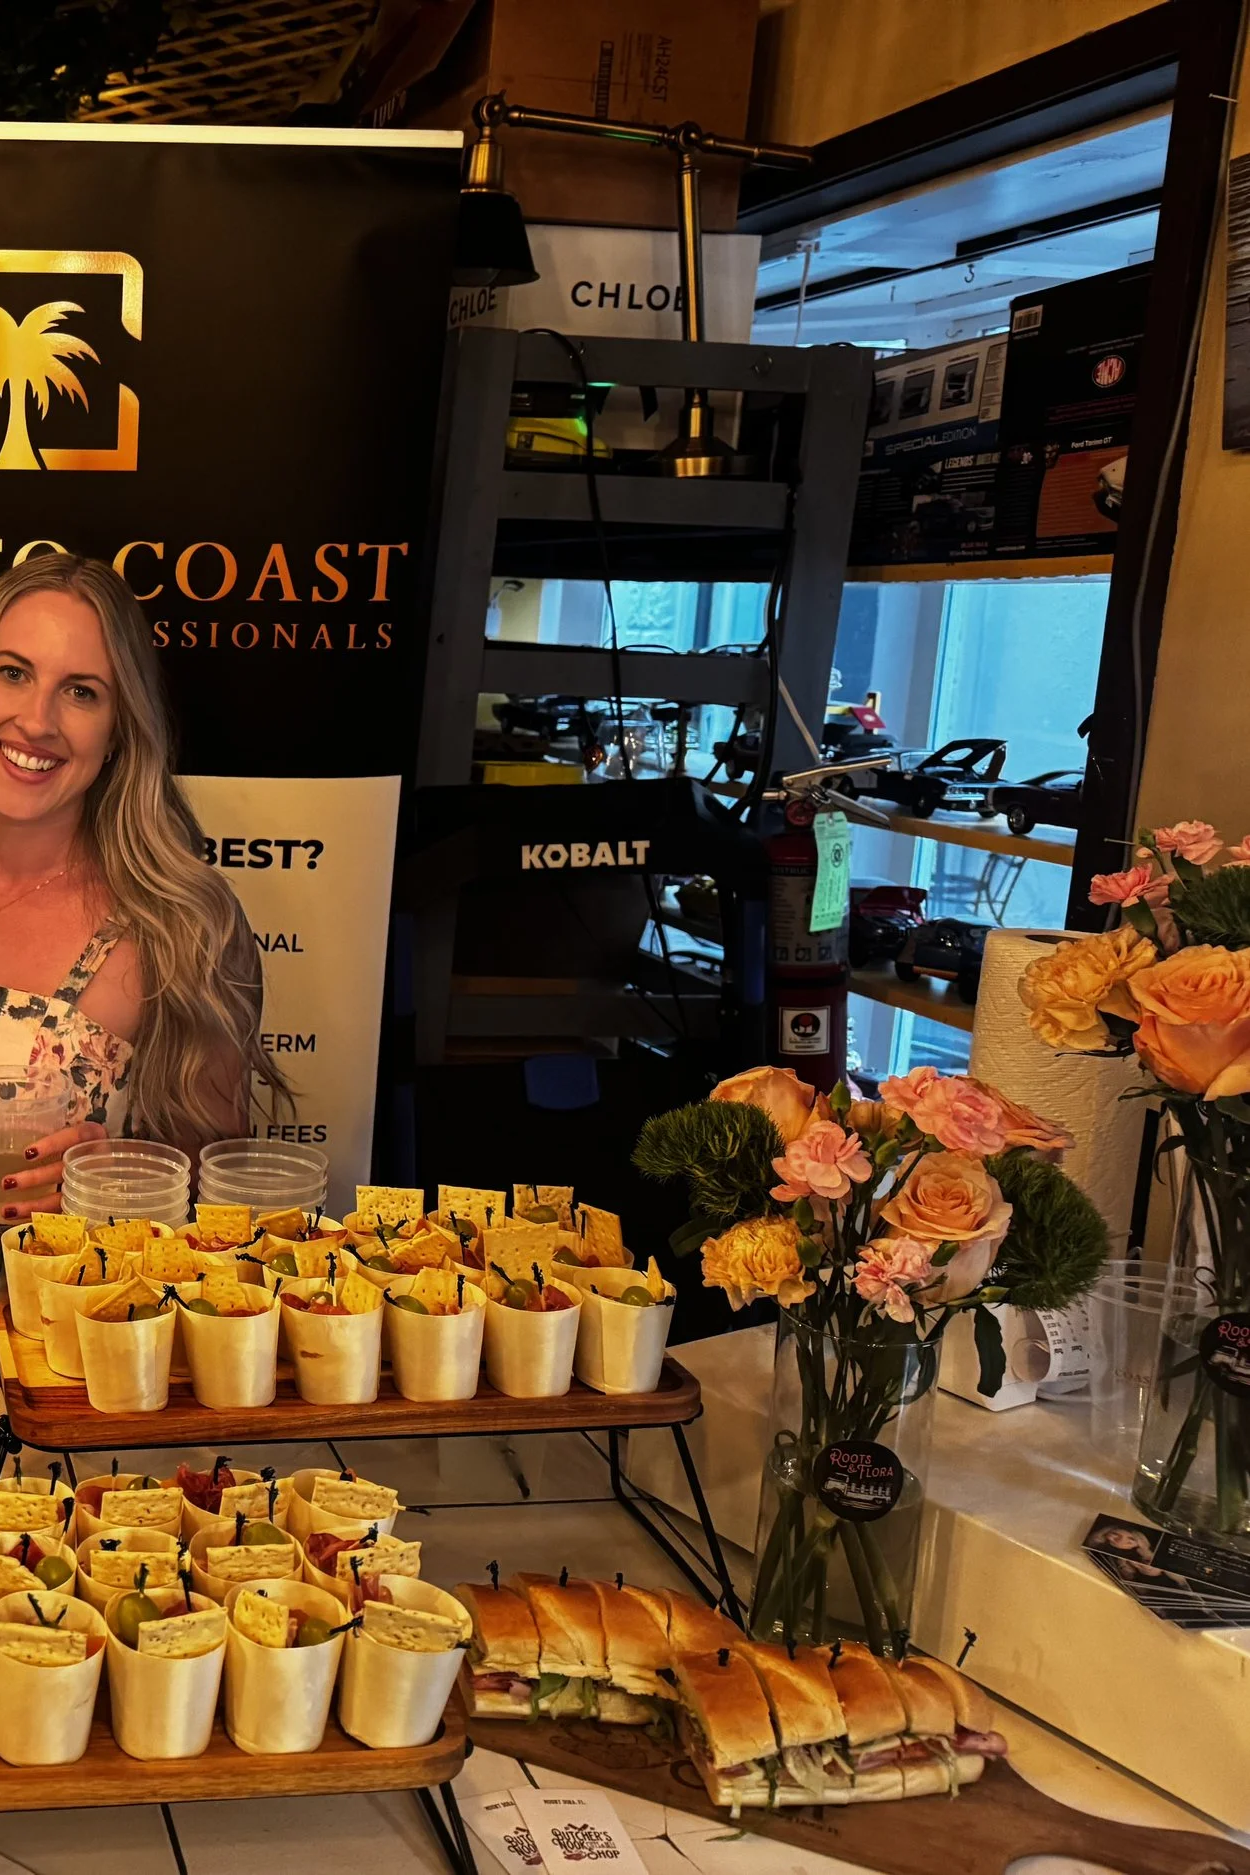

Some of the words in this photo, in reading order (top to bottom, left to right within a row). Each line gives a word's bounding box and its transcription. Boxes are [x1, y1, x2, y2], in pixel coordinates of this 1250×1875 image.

[885, 436, 945, 456] SPECIAL
[112, 541, 409, 603] COAST
[200, 838, 324, 870] BEST?
[521, 840, 651, 870] KOBALT
[830, 1448, 872, 1468] ROOTS
[847, 1463, 857, 1474] &
[856, 1464, 894, 1480] FLORA
[551, 1828, 612, 1842] BUTCHER'S
[586, 1849, 621, 1860] SHOP
